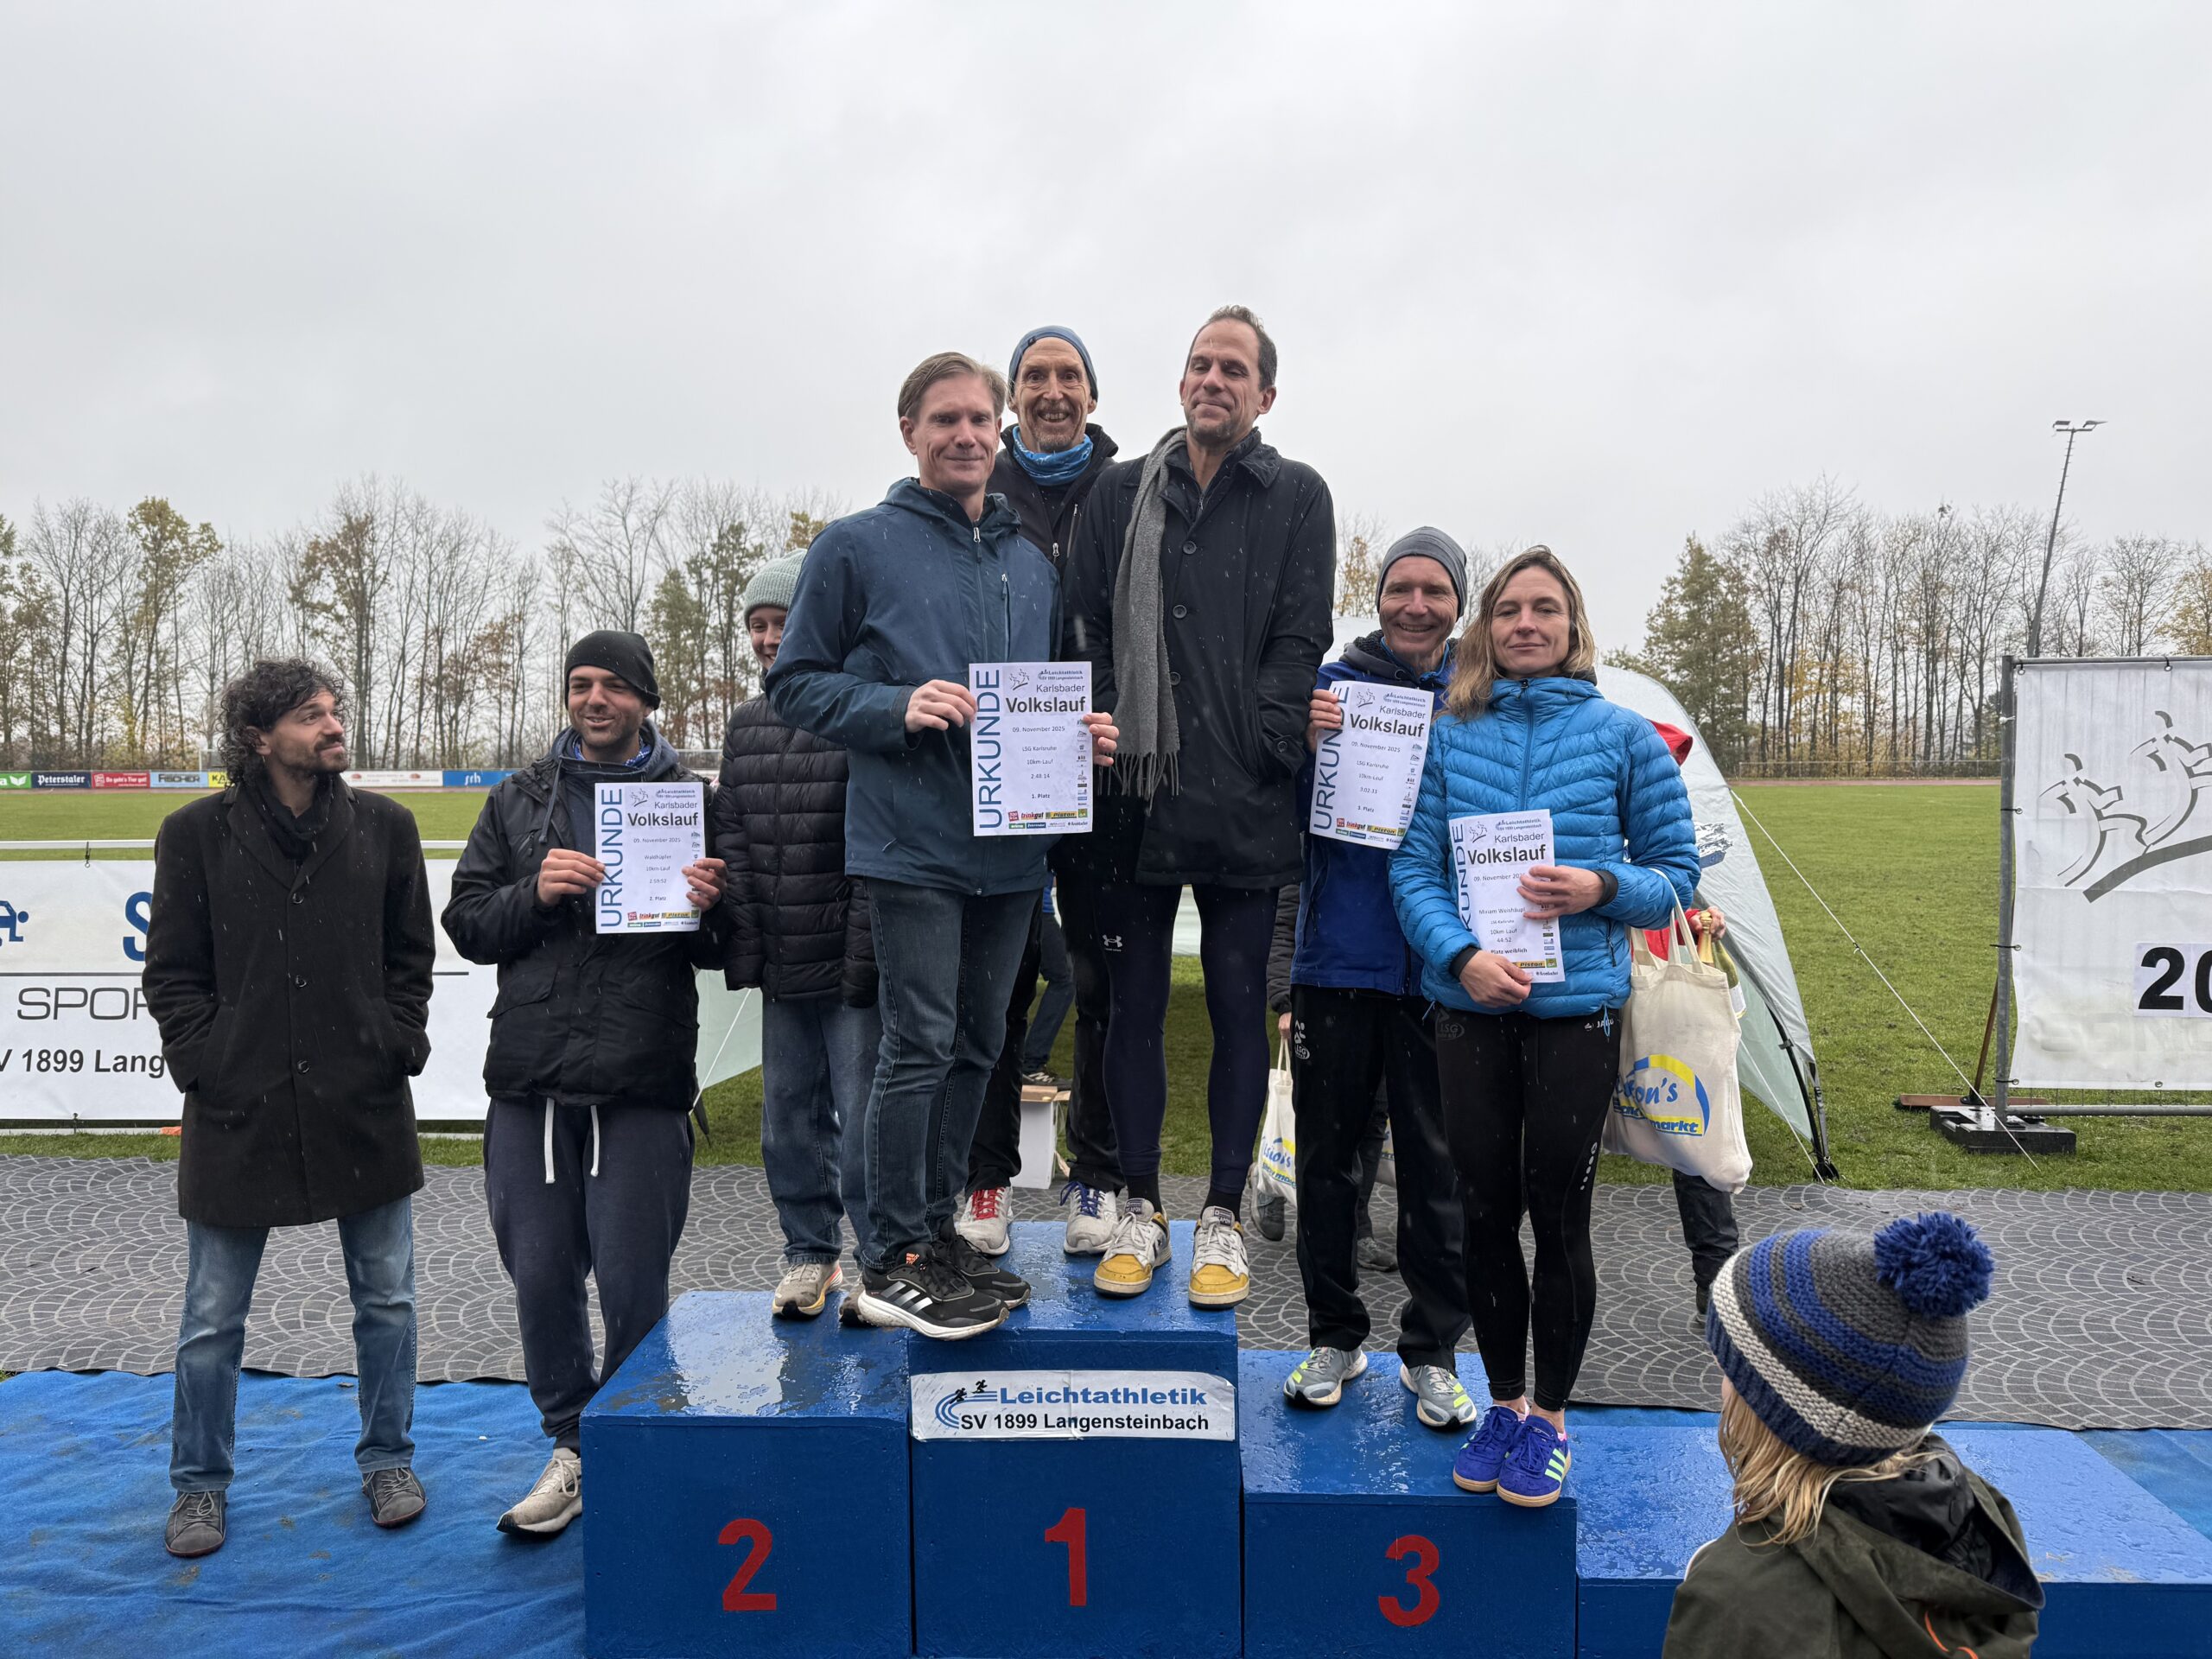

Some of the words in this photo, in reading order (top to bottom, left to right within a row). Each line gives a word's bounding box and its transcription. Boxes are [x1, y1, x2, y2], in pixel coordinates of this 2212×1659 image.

[1036, 683, 1085, 692] Karlsbader
[1005, 696, 1086, 713] Volkslauf
[1379, 705, 1427, 719] Karlsbader
[1349, 713, 1426, 738] Volkslauf
[976, 669, 1002, 830] URKUNDE
[1360, 742, 1387, 751] November
[37, 774, 85, 786] Peterstaler
[627, 812, 699, 826] Volkslauf
[1495, 832, 1545, 843] Karlsbader
[601, 788, 624, 927] URKUNDE
[1468, 844, 1546, 865] Volkslauf
[1452, 823, 1472, 931] KUNDE
[1597, 1019, 1614, 1028] JAO
[22, 1048, 85, 1072] 1899
[1000, 1386, 1208, 1405] Leichtathletik
[961, 1414, 988, 1430] SV
[994, 1413, 1038, 1429] 1899
[1044, 1412, 1210, 1434] Langensteinbach
[716, 1517, 778, 1612] 2
[1044, 1507, 1087, 1607] 1
[1377, 1534, 1440, 1627] 3
